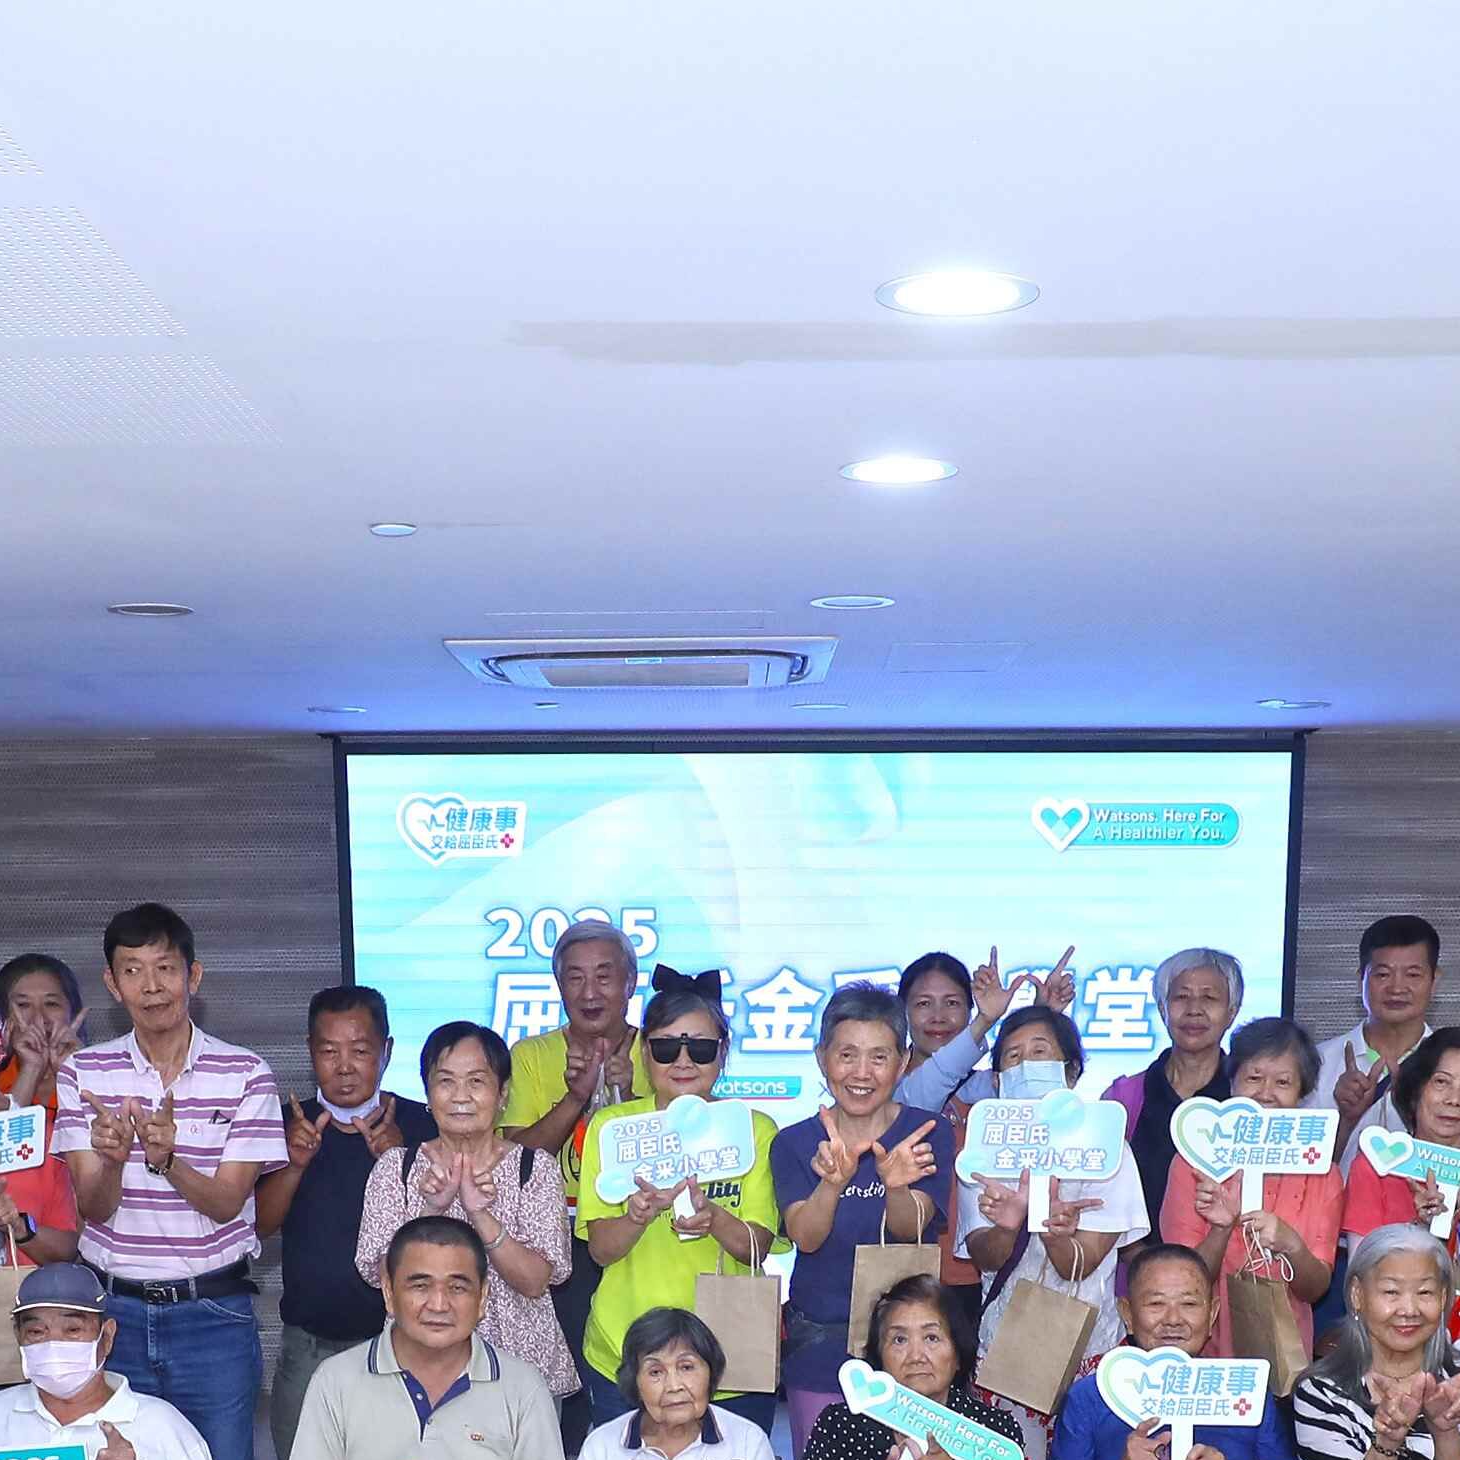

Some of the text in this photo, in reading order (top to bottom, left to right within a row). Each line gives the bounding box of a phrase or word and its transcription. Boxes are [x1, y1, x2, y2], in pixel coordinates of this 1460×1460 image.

[445, 806, 519, 832] 健康事
[1092, 807, 1226, 823] Watsons. Here For
[430, 834, 499, 849] 交給屈臣氏
[1092, 826, 1227, 840] A Healthier You.
[484, 907, 659, 959] 205
[985, 1106, 1034, 1121] 2025
[613, 1119, 662, 1139] 2025
[982, 1122, 1050, 1146] 屈臣氏
[1232, 1114, 1329, 1145] 健康事
[617, 1132, 682, 1163] 屈臣氏
[1212, 1146, 1300, 1165] 交給屈臣氏
[634, 1146, 741, 1182] 金采小學堂
[995, 1148, 1107, 1171] 金采小學堂
[1413, 1161, 1424, 1172] A
[1161, 1364, 1259, 1396] 健康事
[1140, 1397, 1231, 1416] 交給屈臣氏
[896, 1391, 1011, 1457] Watsons. Here For
